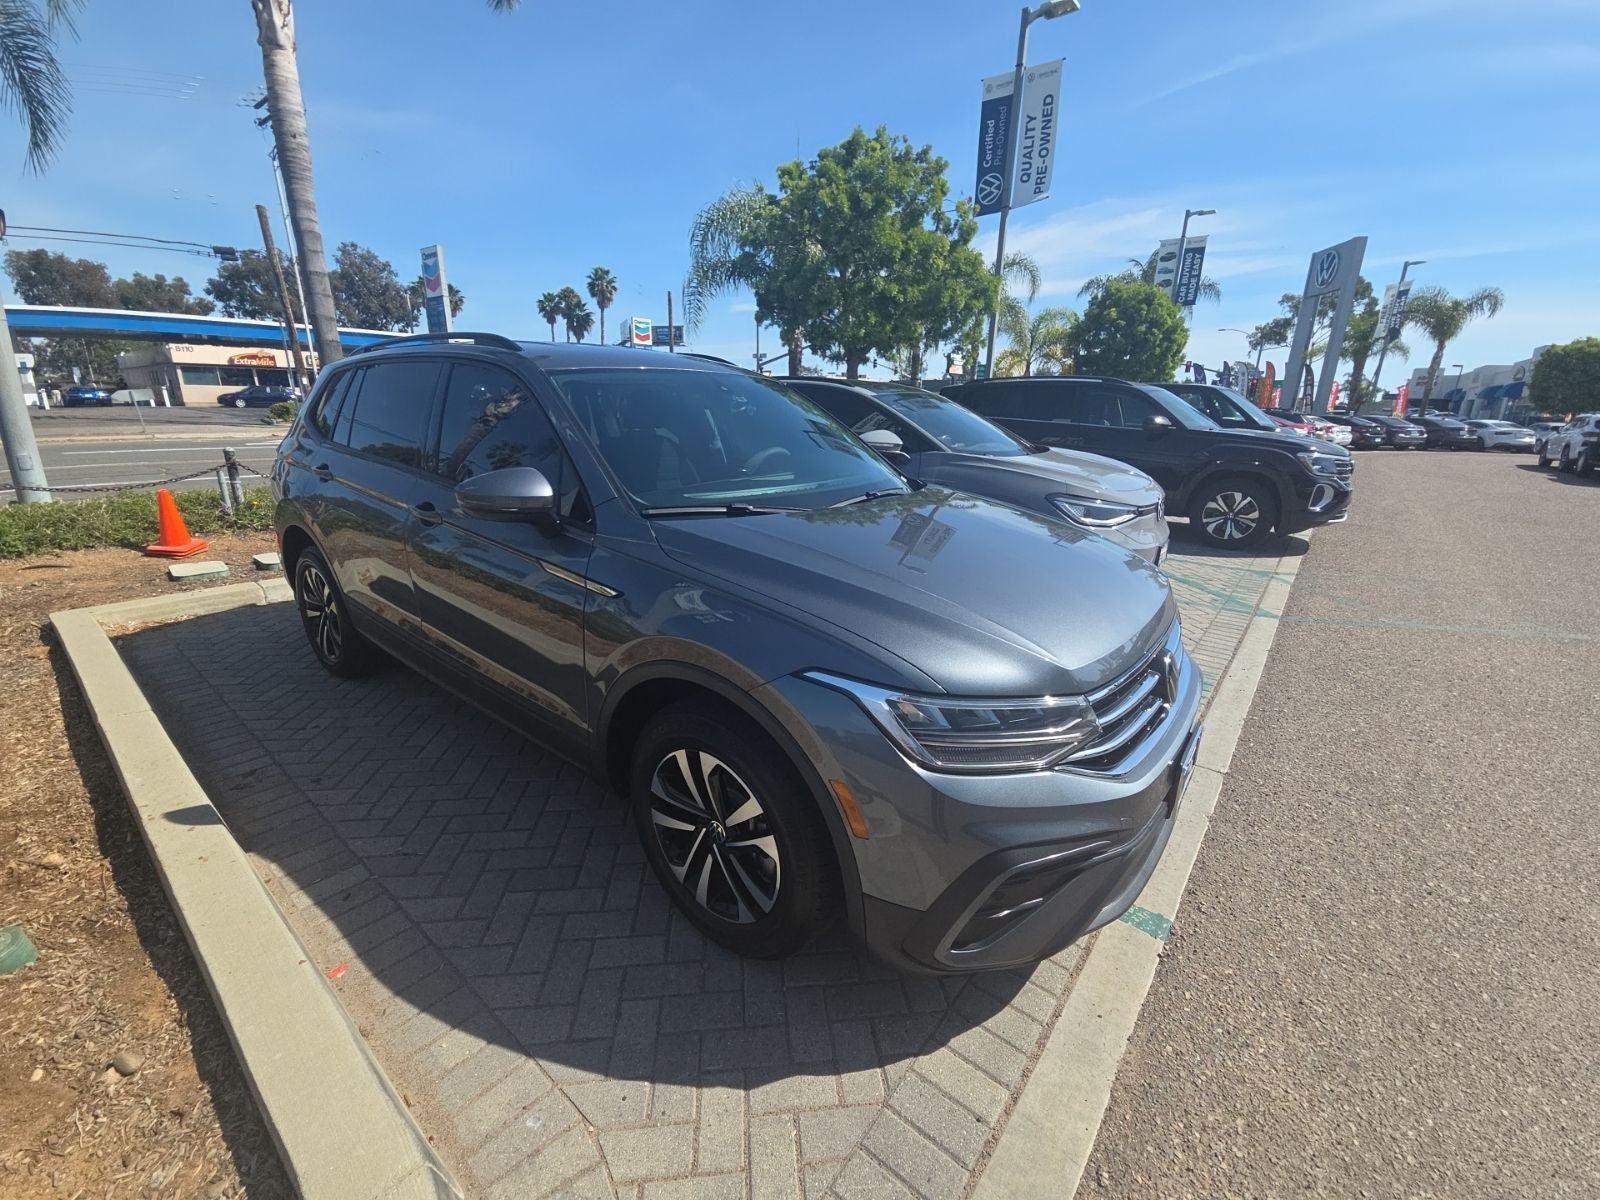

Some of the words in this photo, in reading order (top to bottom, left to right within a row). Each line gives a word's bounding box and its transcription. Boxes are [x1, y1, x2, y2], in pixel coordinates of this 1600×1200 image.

[983, 119, 995, 168] Certified
[994, 105, 1008, 166] Pre-Owned
[1020, 114, 1037, 184] QUALITY
[1033, 93, 1054, 195] PRE-OWNED
[1182, 252, 1193, 285] BUYING
[1192, 253, 1201, 275] EASY
[1178, 286, 1187, 303] CAR
[1187, 276, 1198, 300] MADE
[175, 345, 194, 353] 8110
[234, 357, 275, 367] ExtraMile
